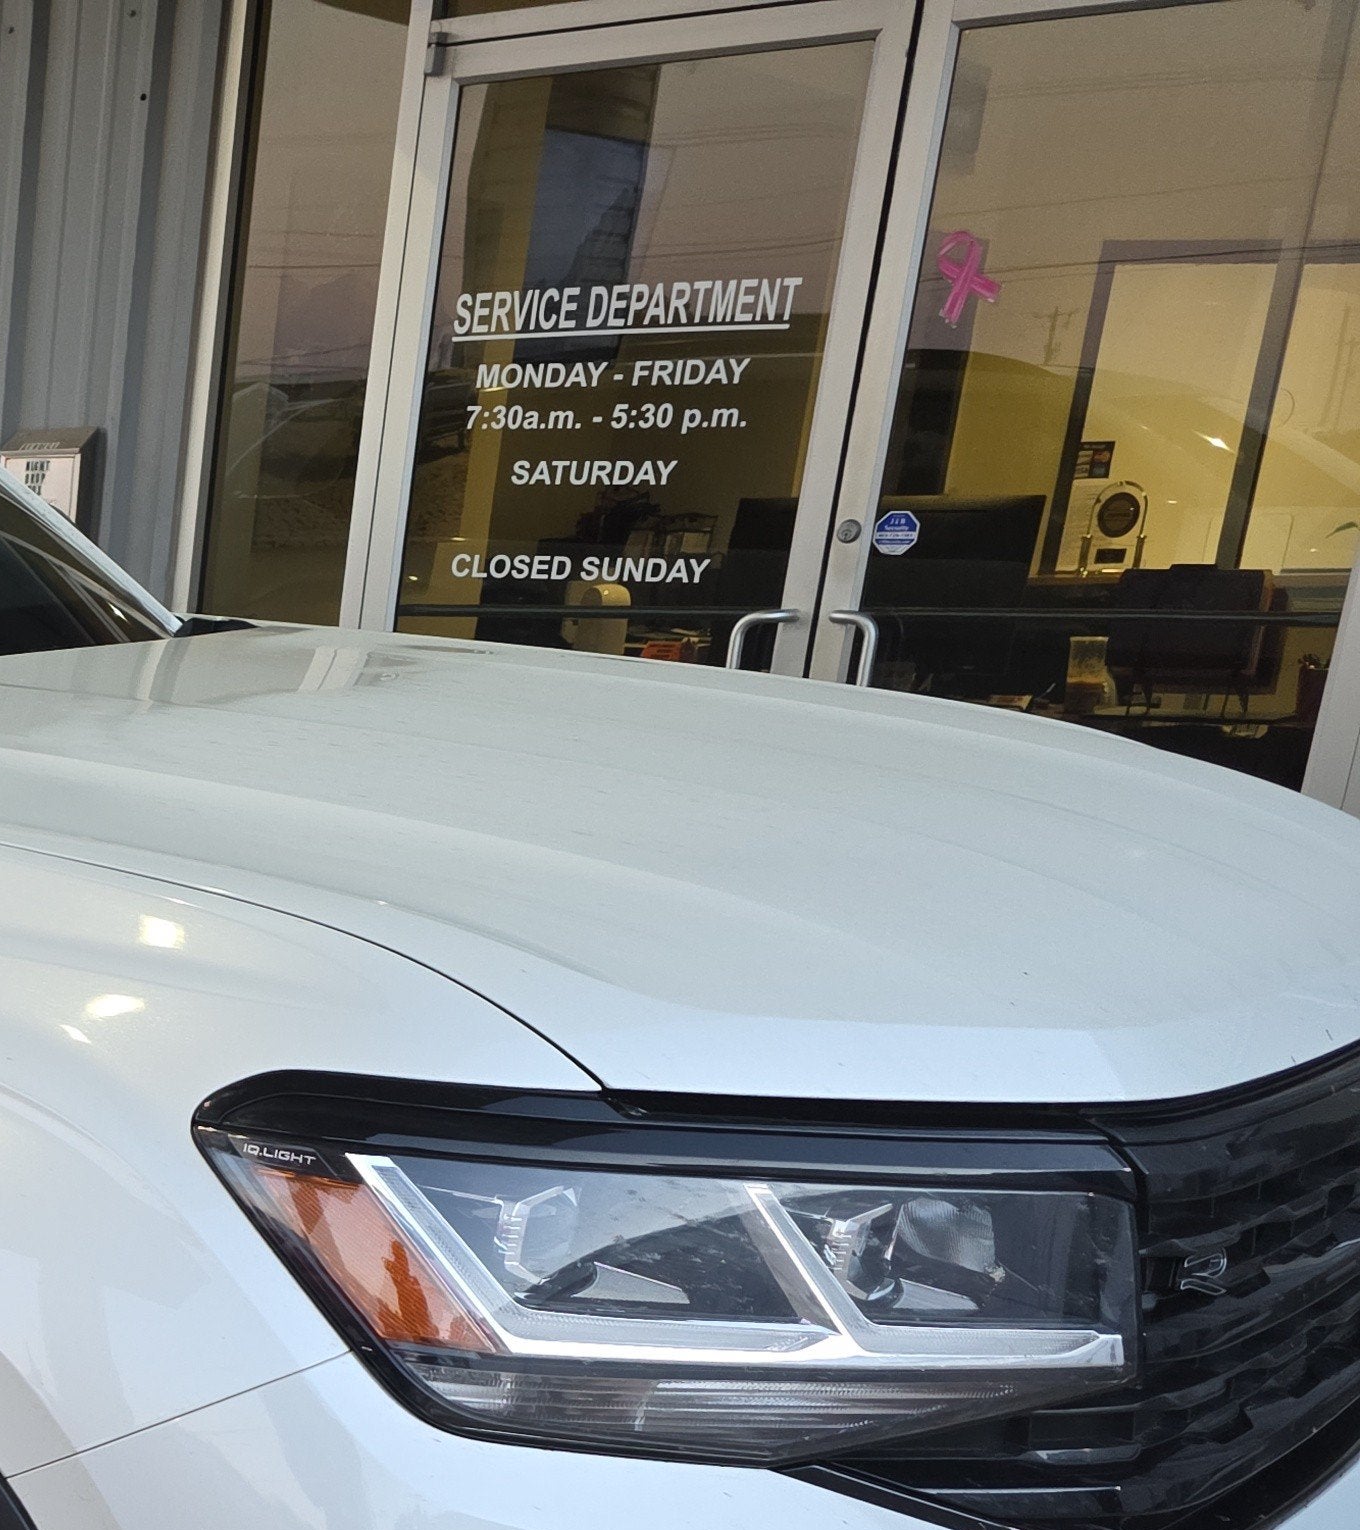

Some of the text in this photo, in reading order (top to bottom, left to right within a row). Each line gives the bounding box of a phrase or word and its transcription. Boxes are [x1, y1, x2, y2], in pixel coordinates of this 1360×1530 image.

[453, 277, 803, 335] SERVICE DEPARTMENT
[475, 357, 751, 389] MONDAY - FRIDAY
[465, 403, 747, 434] 7:30a.m. - 5:30 p.m.
[510, 460, 678, 486] SATURDAY
[451, 554, 711, 584] CLOSED SUNDAY
[242, 1142, 317, 1165] IQ.LIGHT
